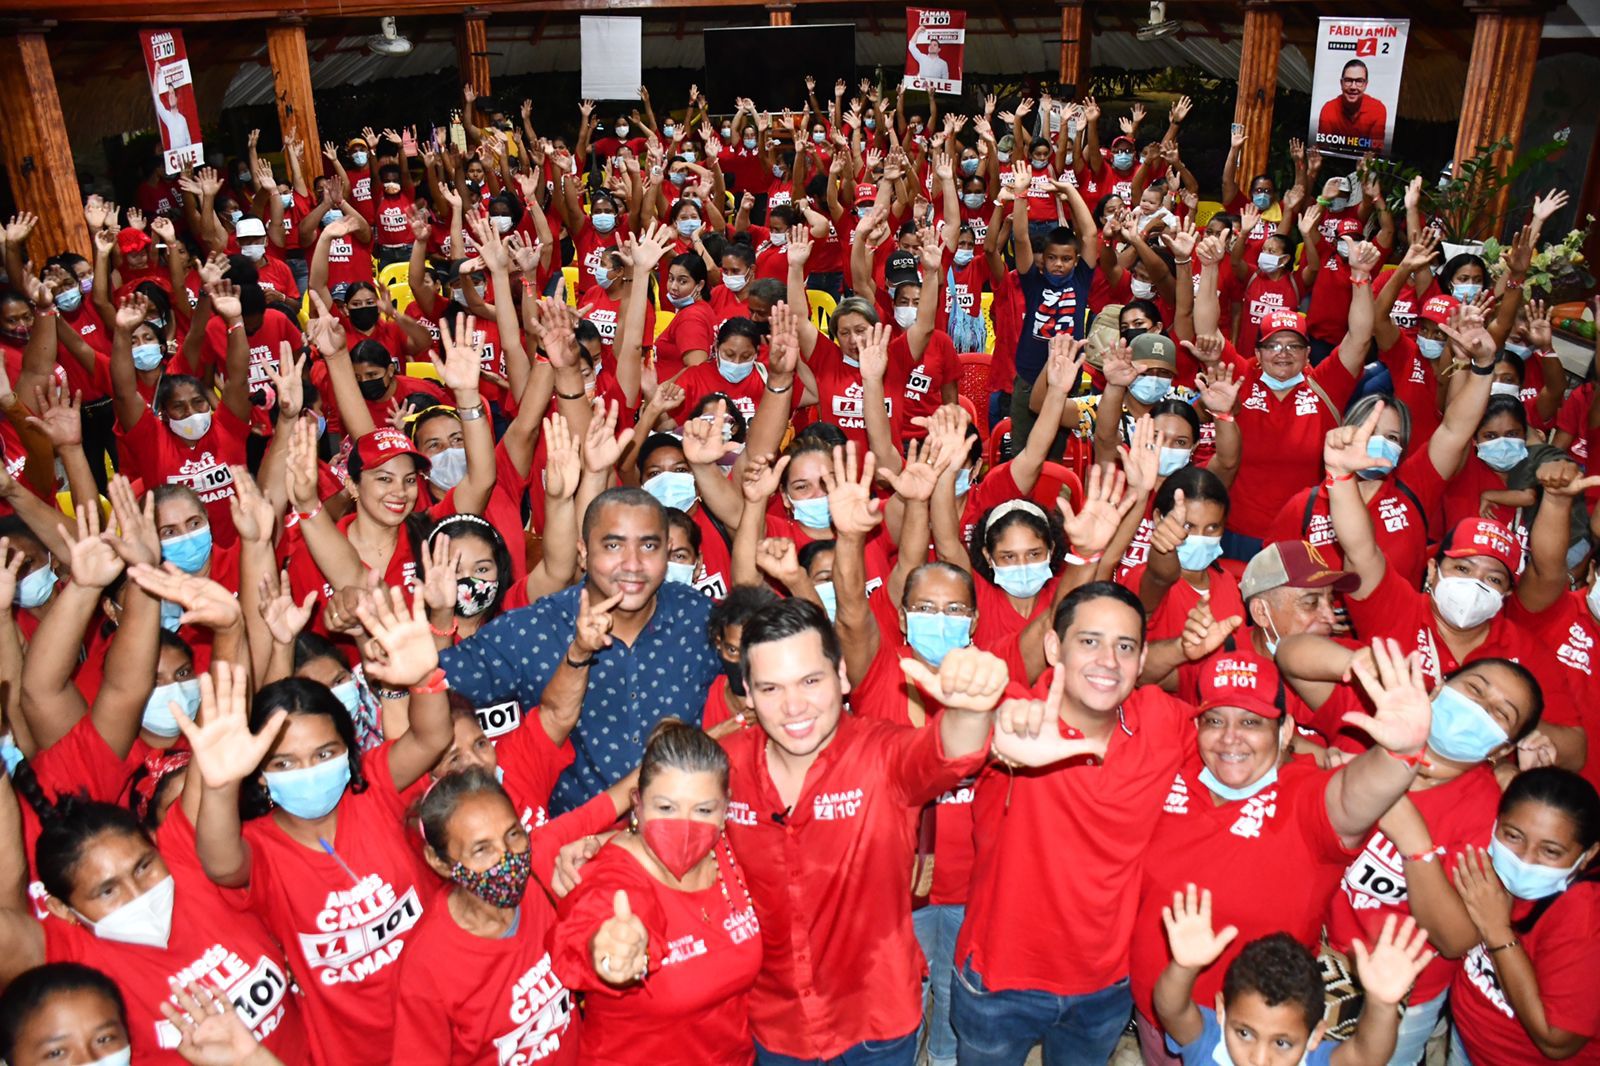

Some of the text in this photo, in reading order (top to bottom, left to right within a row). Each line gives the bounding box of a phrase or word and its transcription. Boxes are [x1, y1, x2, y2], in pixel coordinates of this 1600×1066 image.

[934, 17, 949, 25] 101
[1329, 25, 1397, 37] FABIO AMÍN
[163, 42, 174, 55] 101
[1382, 42, 1390, 54] 2
[913, 80, 952, 91] CALLE
[1316, 133, 1326, 142] ES
[1326, 134, 1346, 145] CON
[1433, 305, 1447, 314] 101
[601, 324, 617, 334] 101
[1282, 320, 1297, 328] 101
[481, 347, 492, 356] 01
[738, 403, 756, 413] LLE
[839, 417, 866, 428] CÁM
[392, 440, 411, 450] 101
[206, 466, 231, 485] 101
[200, 487, 235, 503] MARA
[1321, 529, 1336, 540] 10
[1477, 522, 1513, 544] CALLE
[1491, 537, 1510, 557] 101
[700, 579, 724, 597] 01
[1216, 660, 1258, 673] CALLE
[1231, 674, 1257, 689] 101
[478, 706, 517, 732] 101
[814, 788, 864, 805] CÁMARA
[316, 882, 397, 932] CALLE
[372, 897, 416, 941] 101
[321, 938, 405, 986] CÁMAR
[233, 967, 283, 1019] 101
[510, 971, 563, 1024] CALL
